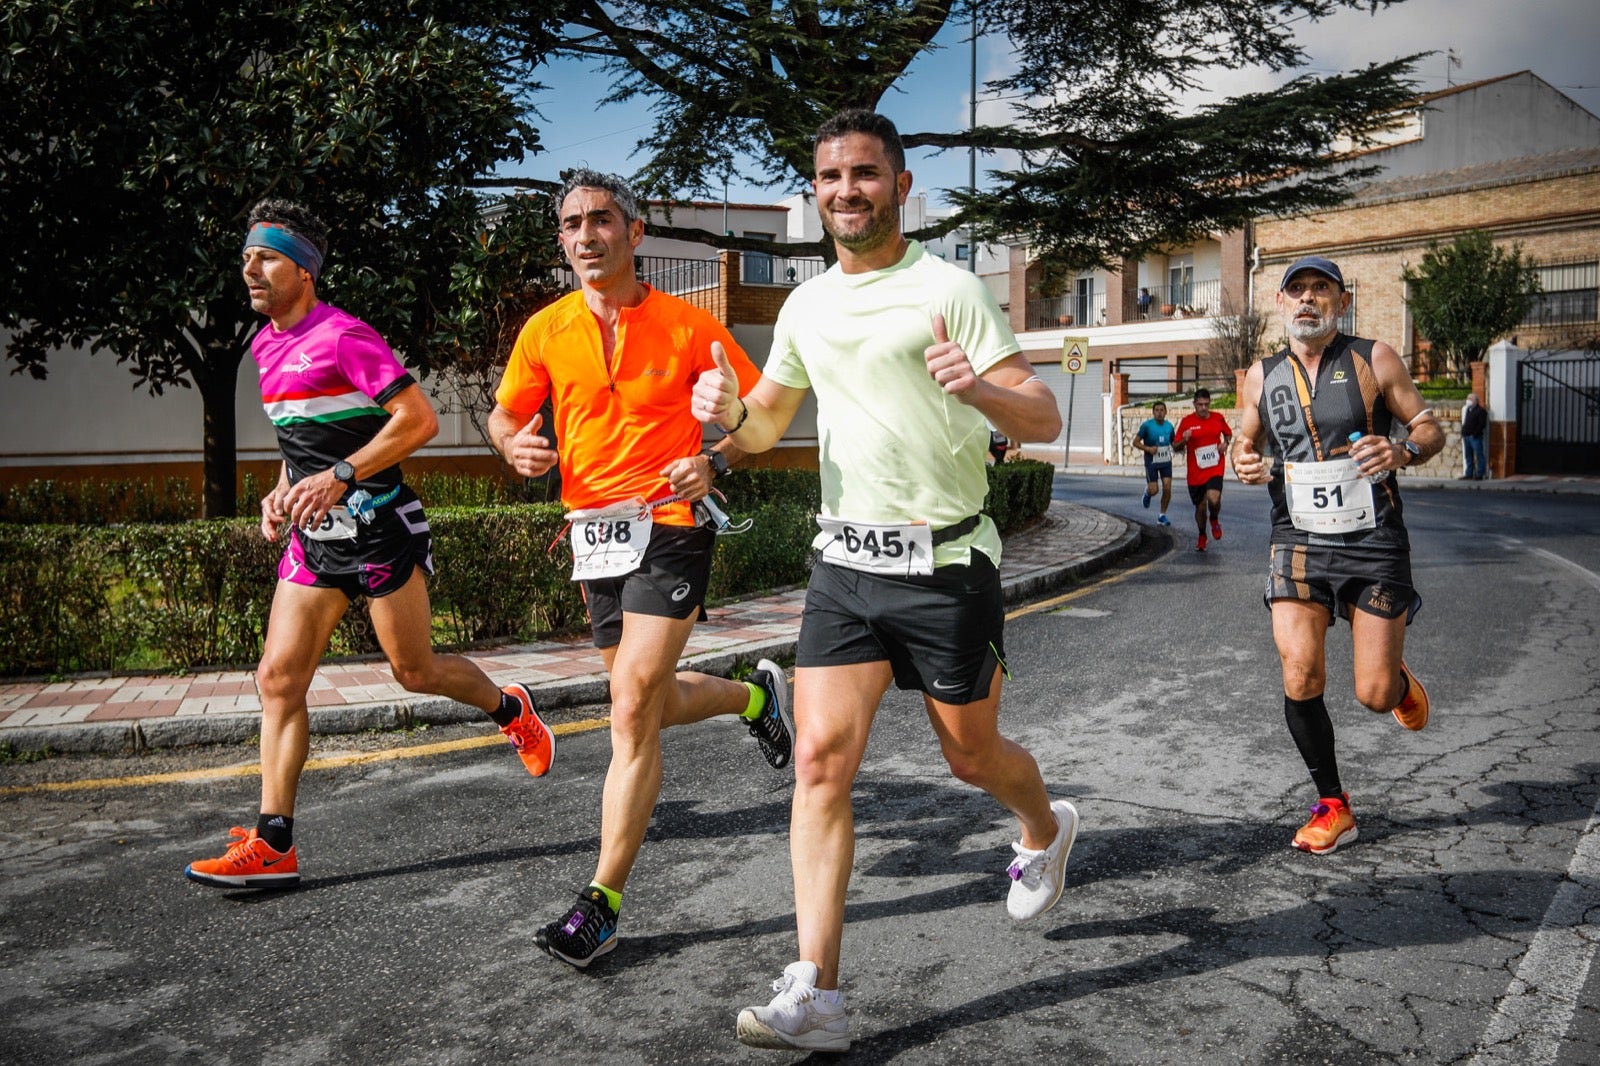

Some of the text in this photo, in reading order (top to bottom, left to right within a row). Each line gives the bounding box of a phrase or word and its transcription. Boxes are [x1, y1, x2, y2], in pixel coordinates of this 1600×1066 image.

[1202, 452, 1216, 461] 409
[1313, 485, 1344, 509] 51
[584, 520, 632, 546] 698
[843, 525, 904, 558] 645
